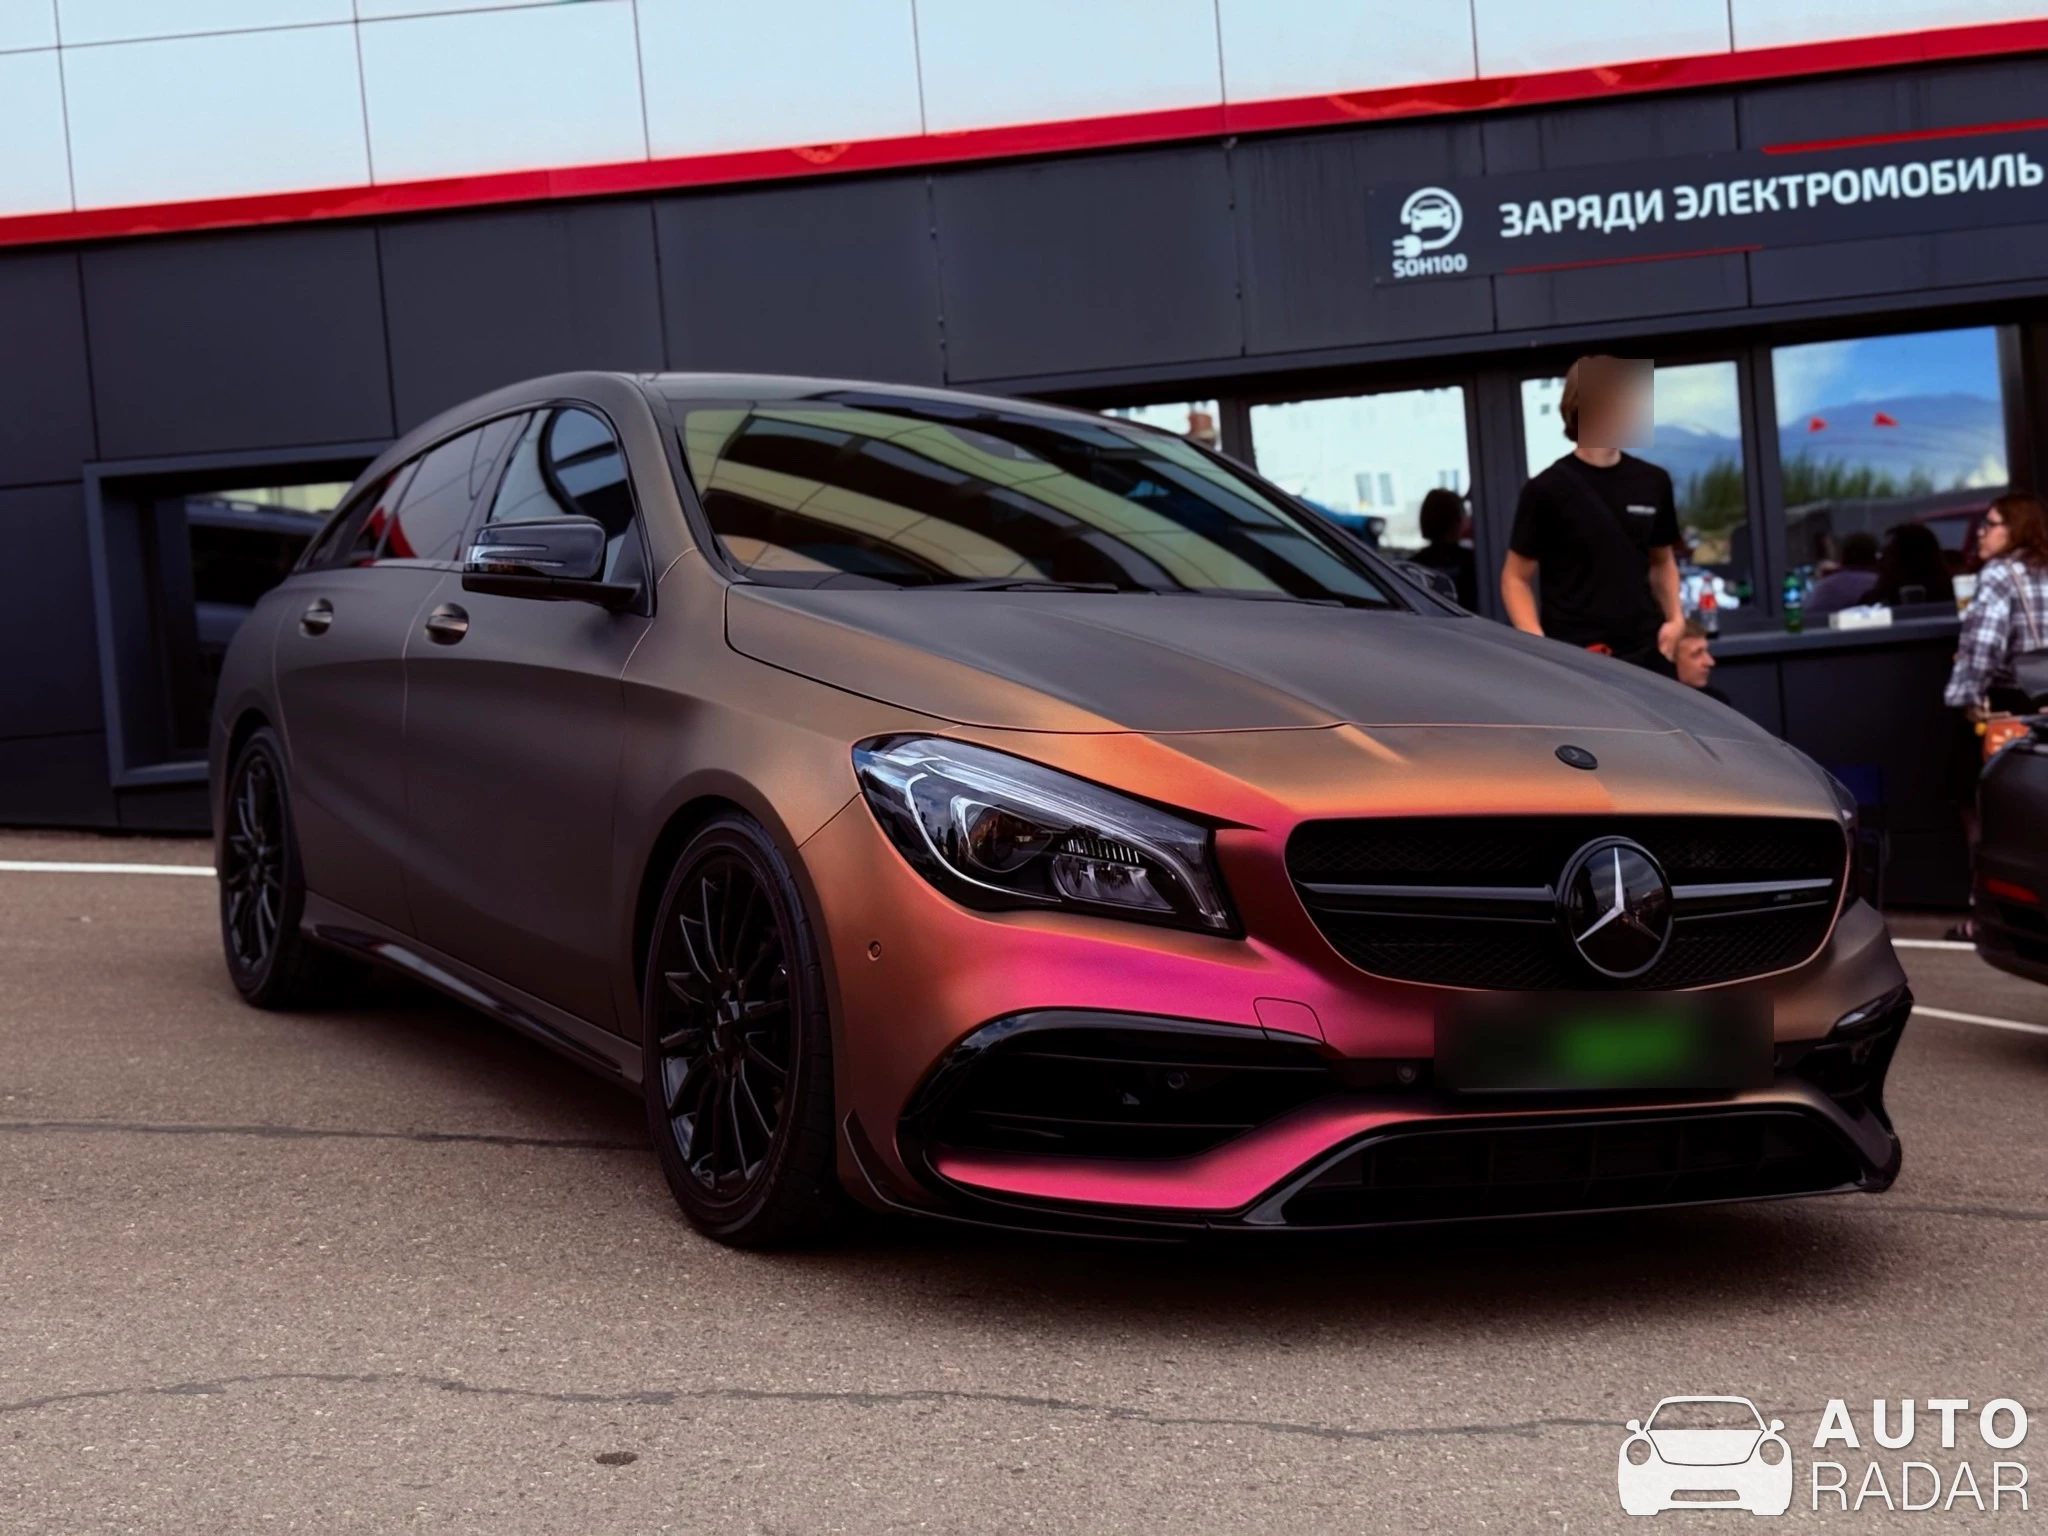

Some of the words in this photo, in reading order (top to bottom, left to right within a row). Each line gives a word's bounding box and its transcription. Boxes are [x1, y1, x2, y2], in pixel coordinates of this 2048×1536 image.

[1499, 189, 1664, 238] ЗАРЯДИ
[1674, 153, 2044, 219] ЭЛЕКТРОМОБИЛЬ
[1392, 252, 1468, 278] SOH100
